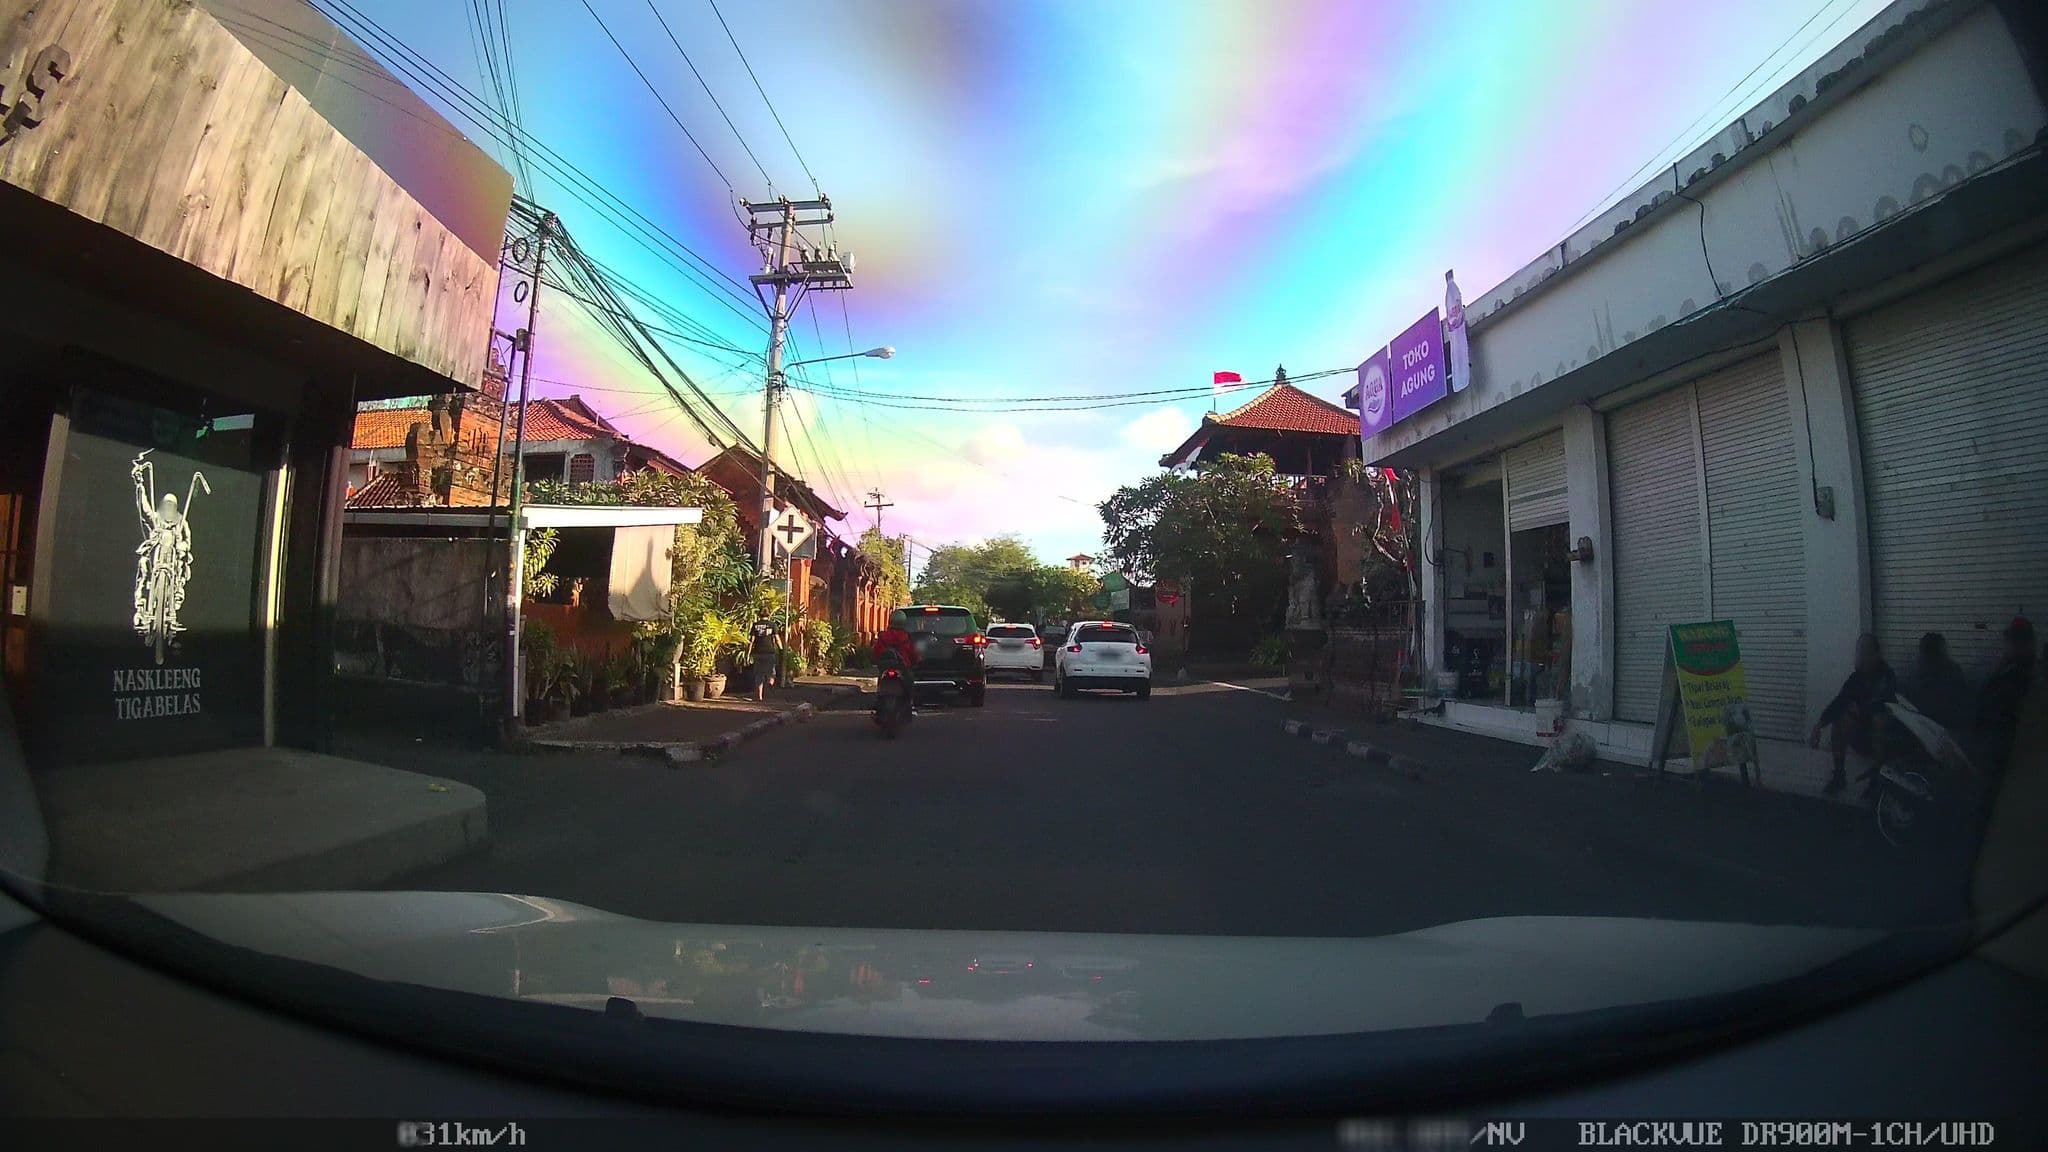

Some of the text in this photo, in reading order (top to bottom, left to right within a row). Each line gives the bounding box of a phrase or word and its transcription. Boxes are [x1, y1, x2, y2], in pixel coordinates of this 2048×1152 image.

[1402, 340, 1429, 370] TOKO
[1400, 363, 1436, 399] AGUNG
[113, 668, 200, 692] NASKLEENG
[115, 693, 200, 720] TIGABELAS
